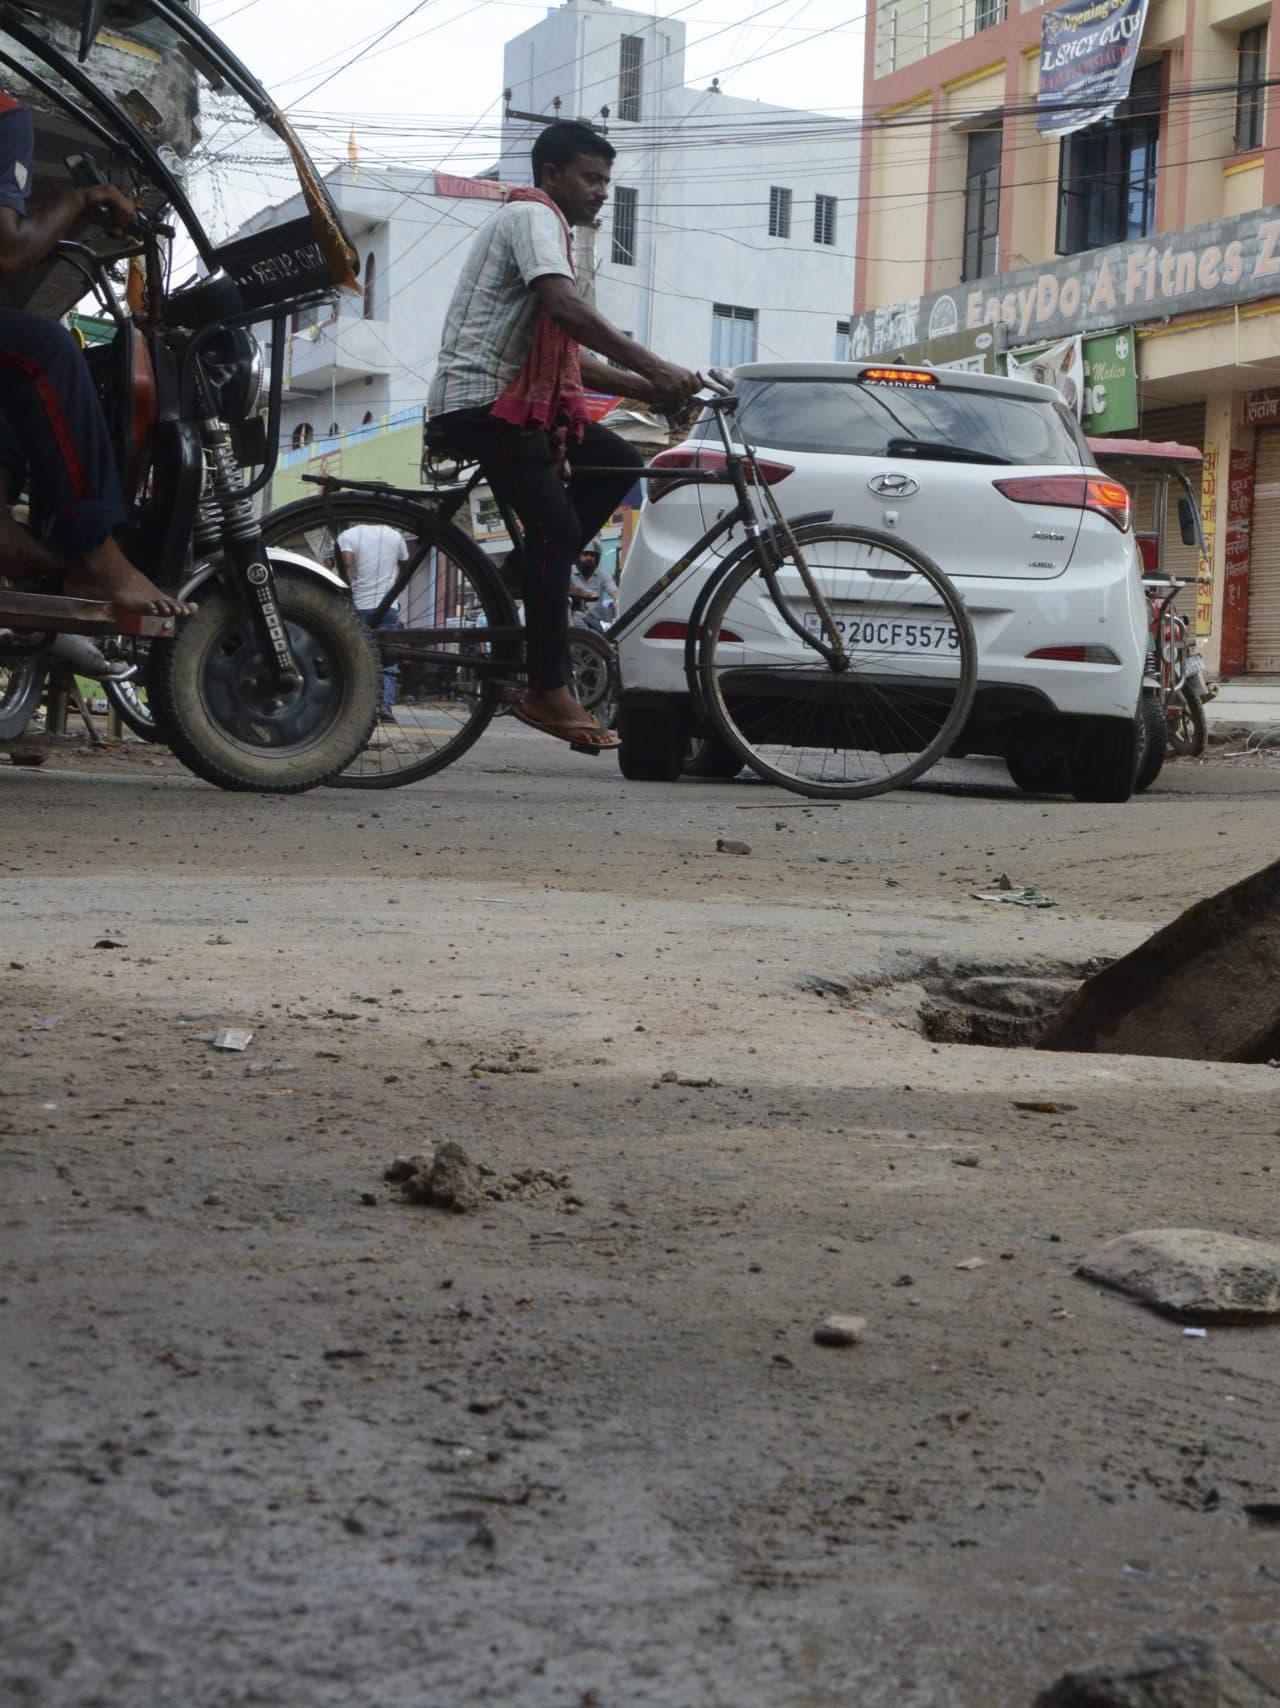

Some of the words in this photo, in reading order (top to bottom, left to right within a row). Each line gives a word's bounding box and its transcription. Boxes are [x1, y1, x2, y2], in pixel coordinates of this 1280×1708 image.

[966, 273, 1081, 337] EasyDo
[1088, 256, 1118, 313] A
[1124, 240, 1244, 306] Fitnes
[1248, 393, 1280, 421] संतोष
